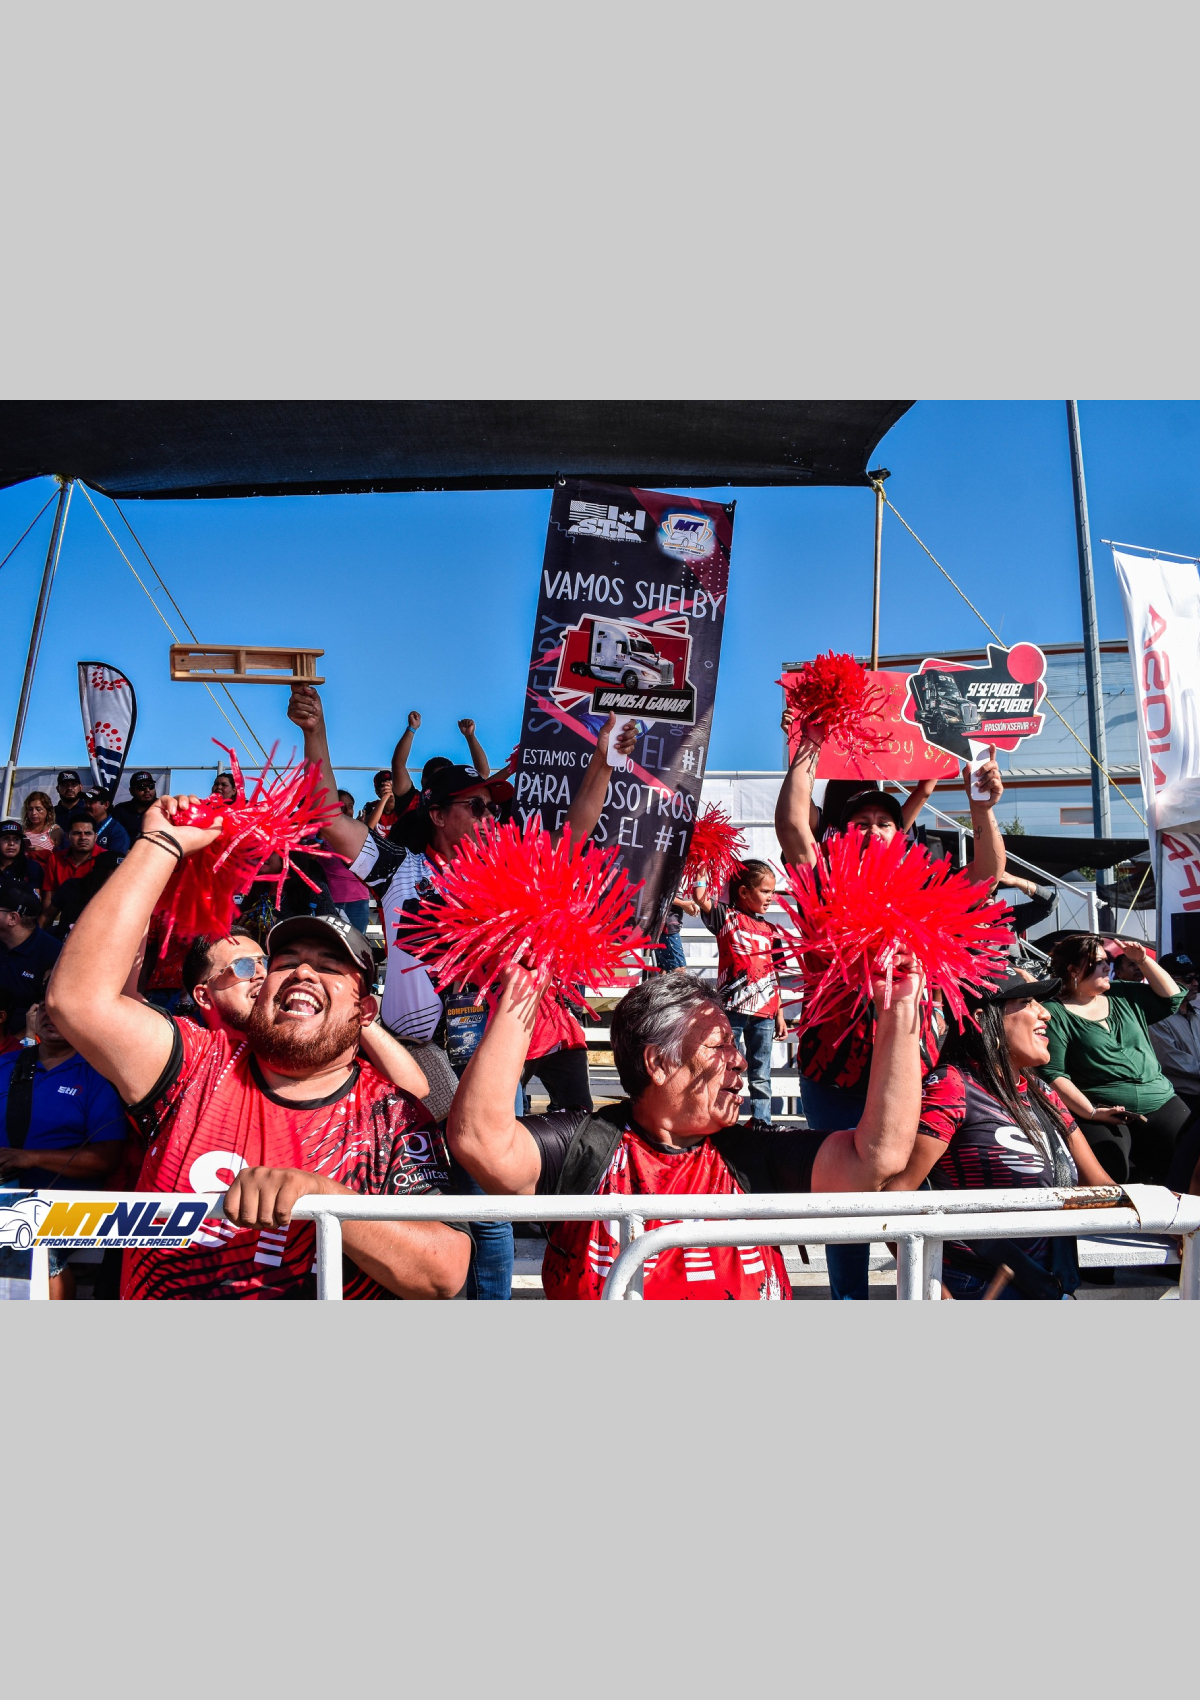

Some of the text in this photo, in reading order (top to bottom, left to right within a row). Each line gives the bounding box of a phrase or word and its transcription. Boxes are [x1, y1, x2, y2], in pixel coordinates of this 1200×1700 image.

[673, 519, 704, 532] MT
[544, 569, 725, 621] VAMOS SHELBY
[967, 682, 1024, 697] SI SE PUEDE!
[598, 692, 691, 713] VAMOS A GANAR!
[977, 698, 1034, 713] SI SE PUEDE!
[523, 748, 576, 767] ESTAMOS
[641, 734, 705, 779] EL #1
[516, 772, 571, 805] PARA
[618, 816, 644, 848] EL
[654, 825, 688, 857] #1
[447, 1005, 484, 1016] COMPETIDOR
[393, 1168, 449, 1187] Quálitas
